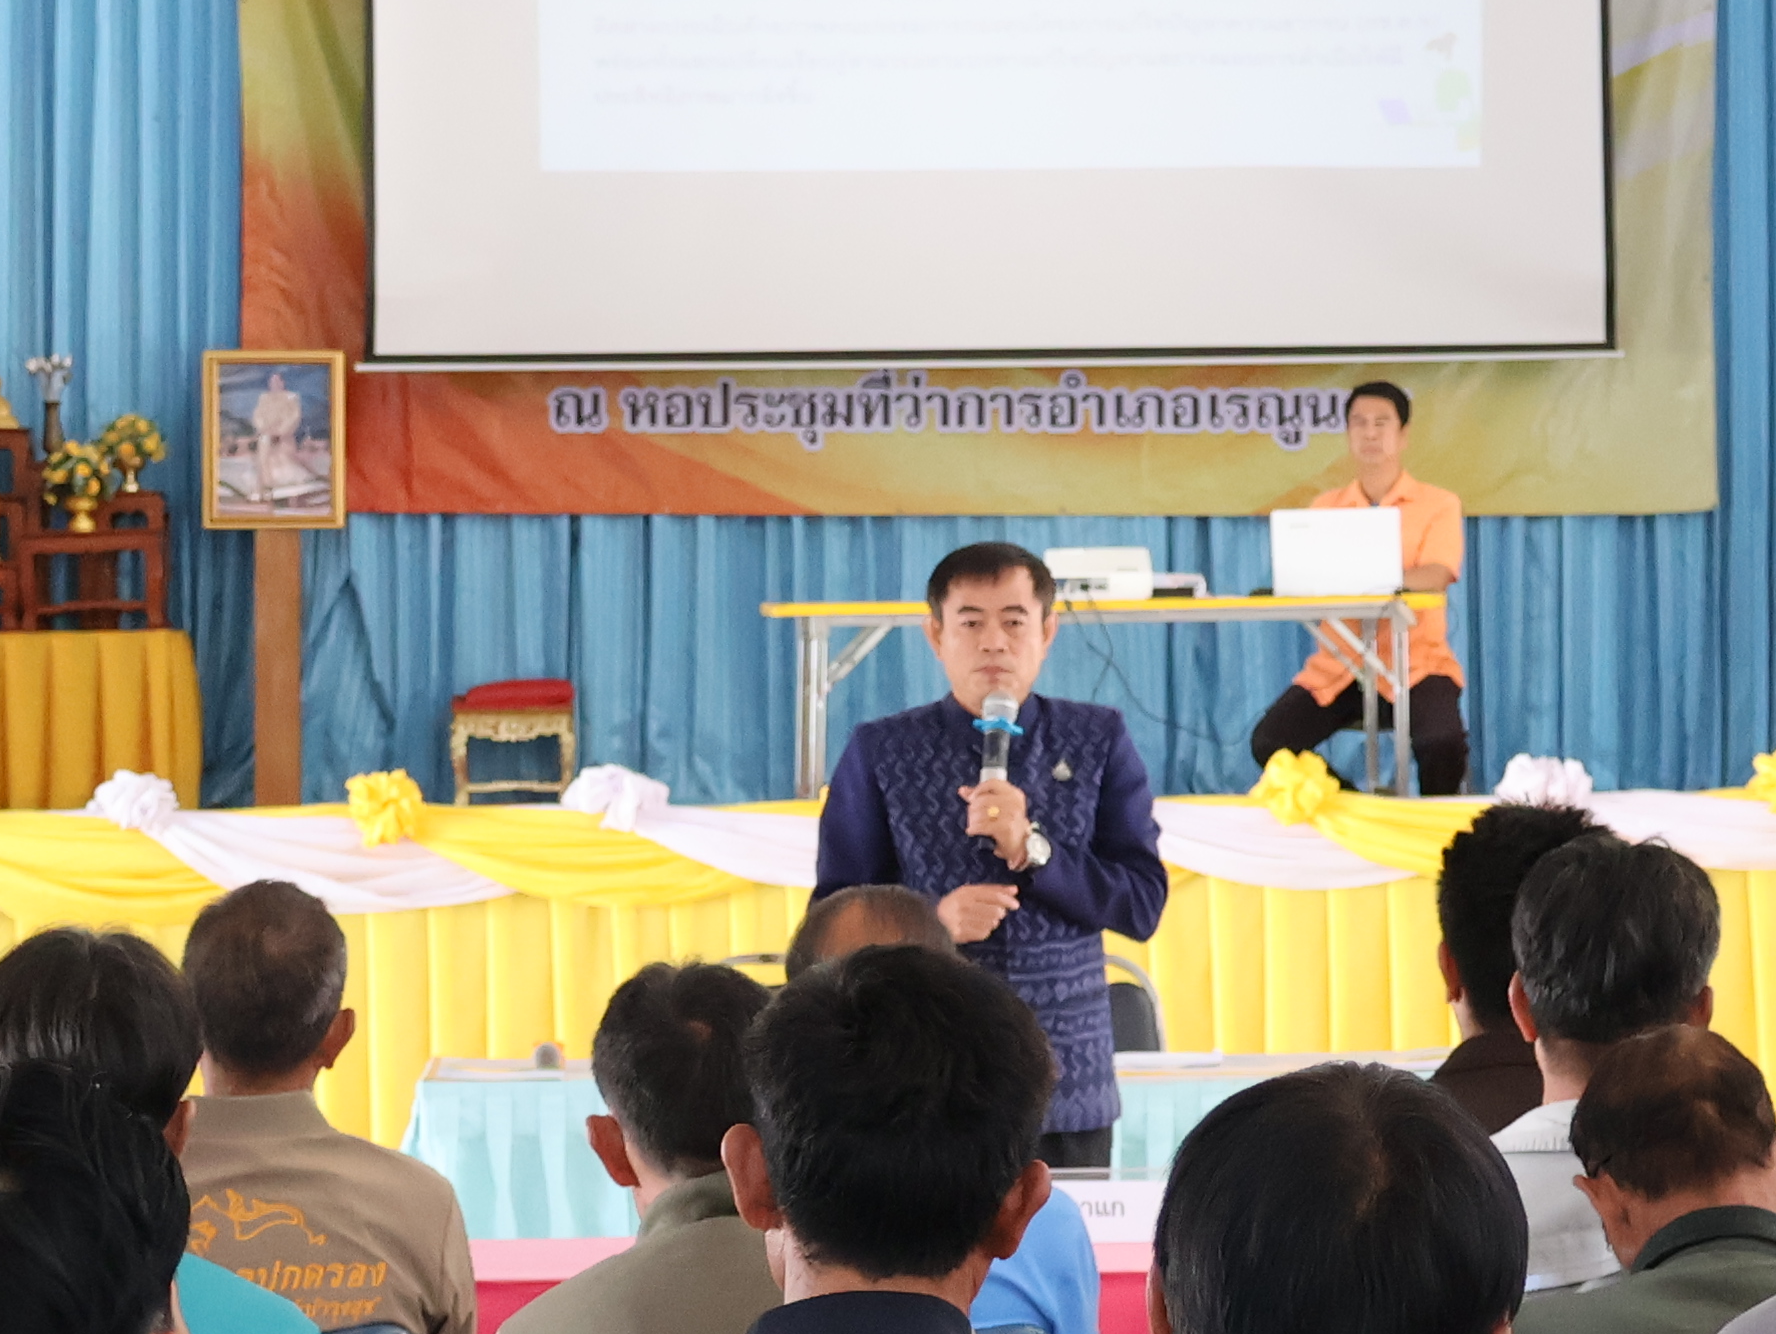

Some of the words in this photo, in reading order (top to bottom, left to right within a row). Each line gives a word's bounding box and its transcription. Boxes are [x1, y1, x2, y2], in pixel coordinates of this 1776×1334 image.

[550, 387, 605, 430] ณ
[623, 370, 1347, 446] หอประชุมที่ว่าการอำเภอเรณูน
